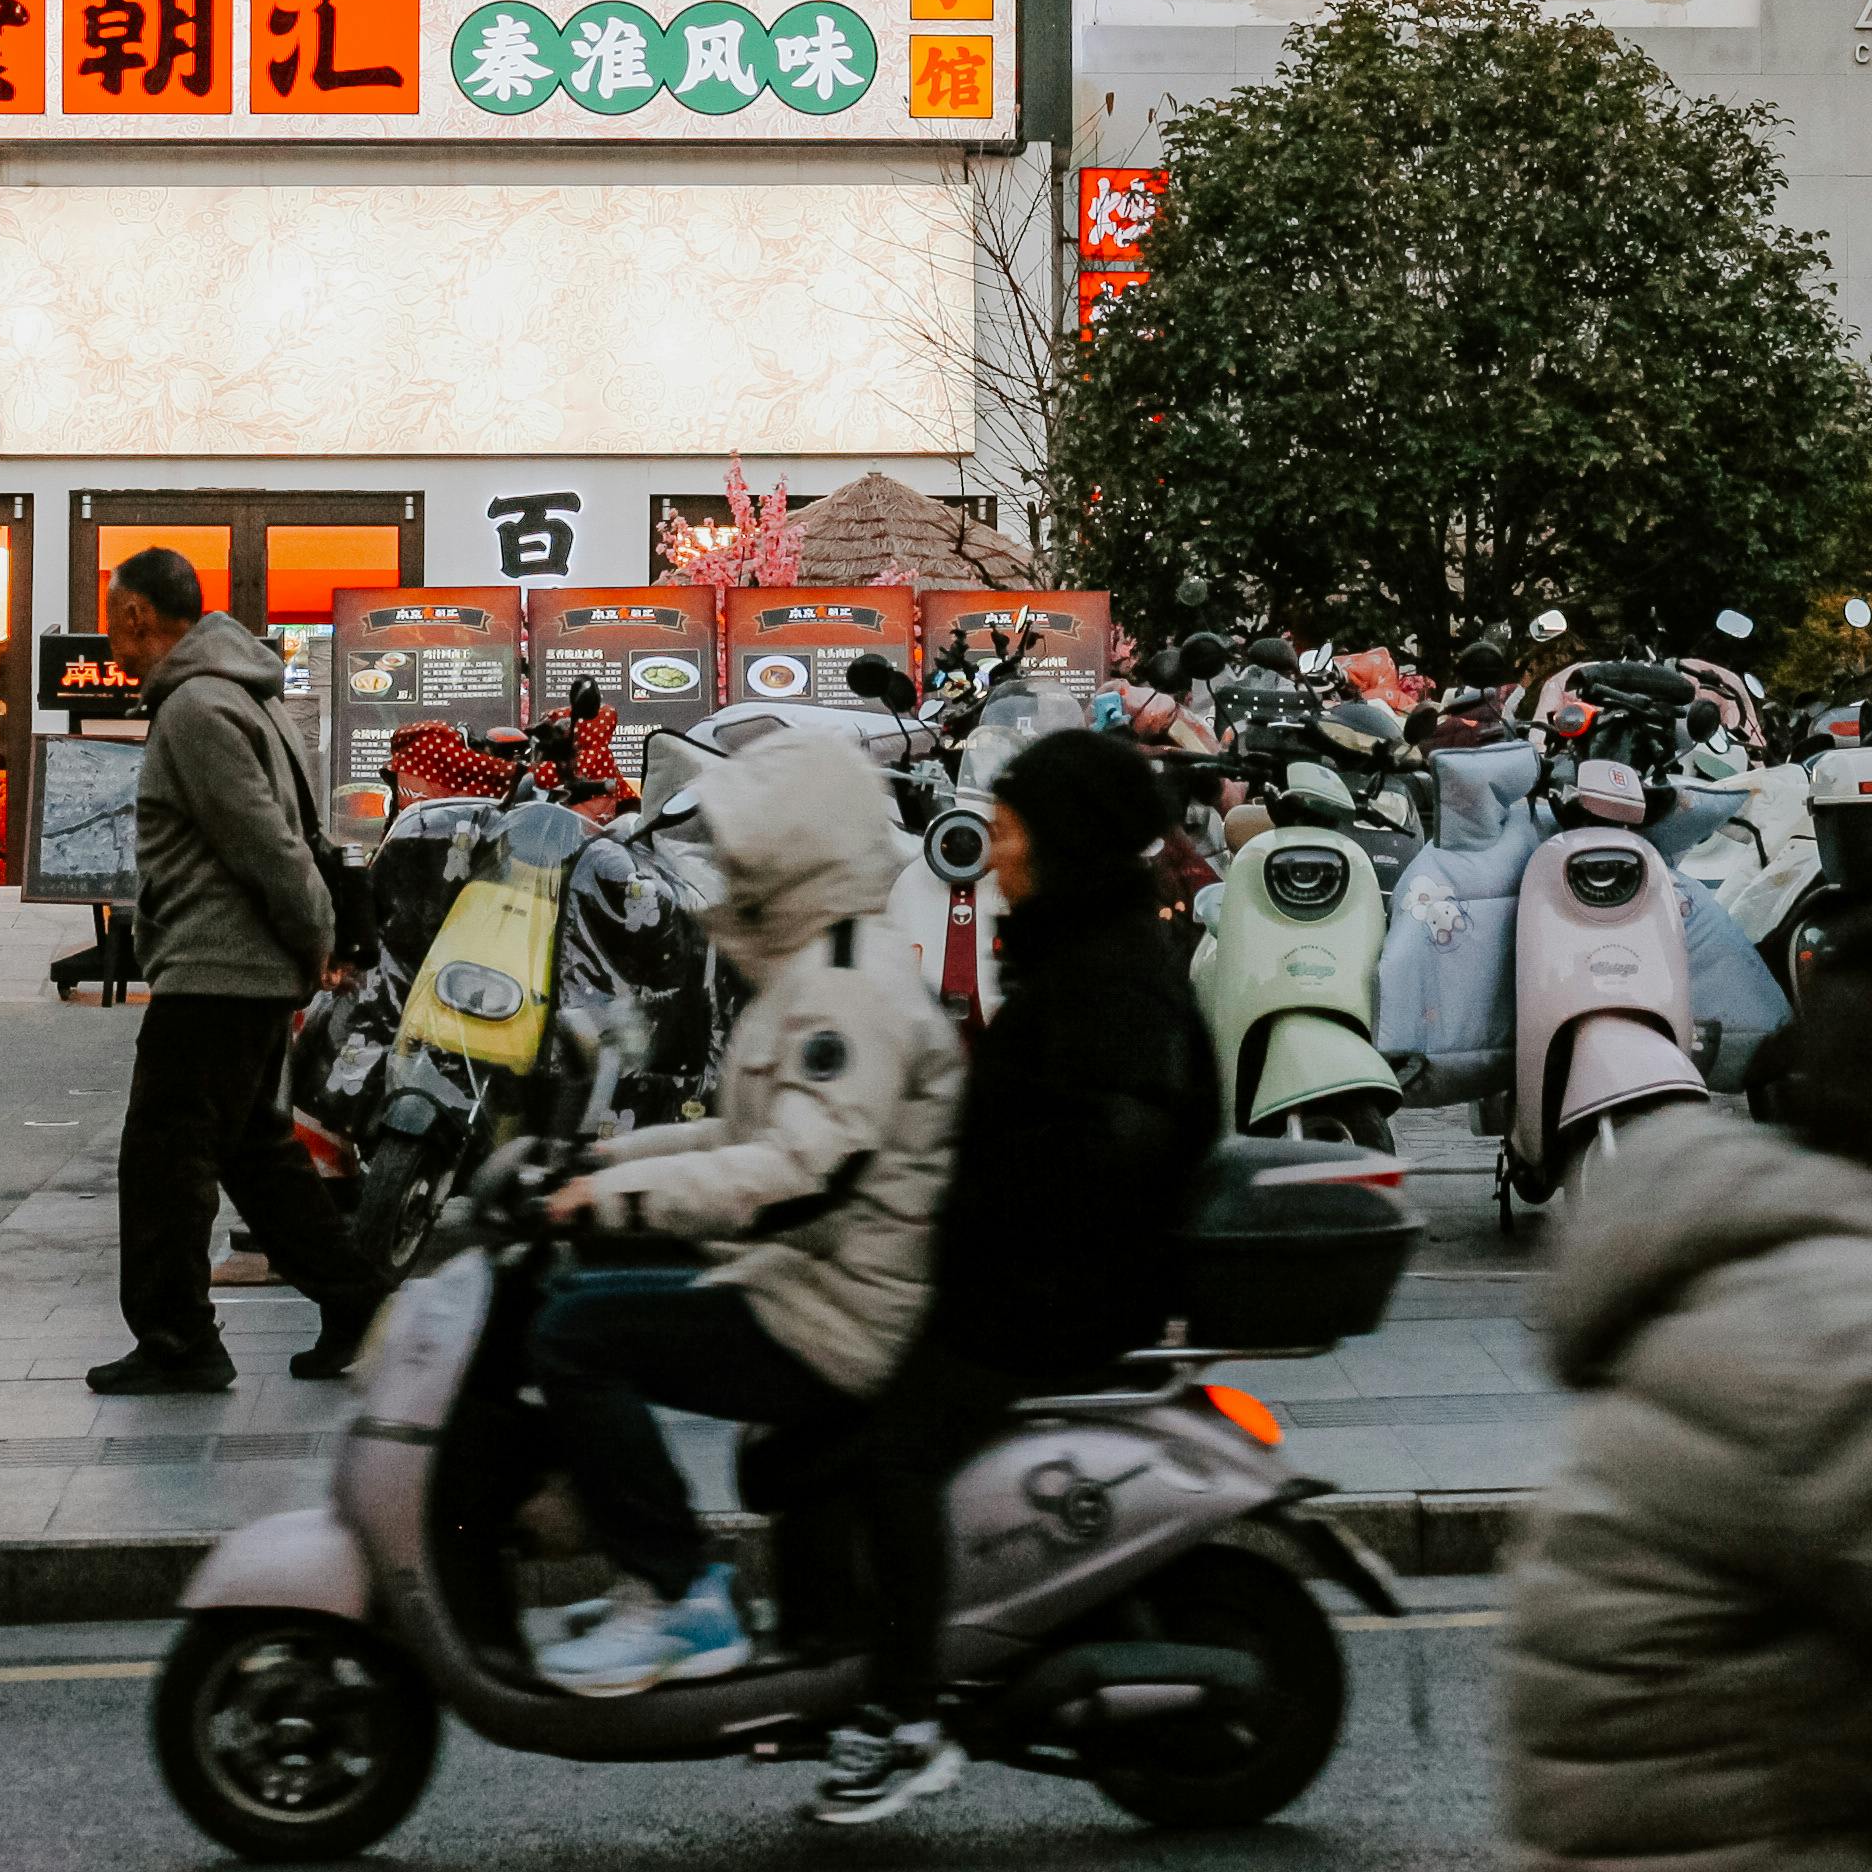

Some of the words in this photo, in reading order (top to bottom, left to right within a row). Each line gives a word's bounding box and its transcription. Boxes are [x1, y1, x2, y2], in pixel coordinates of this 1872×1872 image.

[463, 13, 866, 102] 秦淮风味
[487, 492, 580, 579] 百
